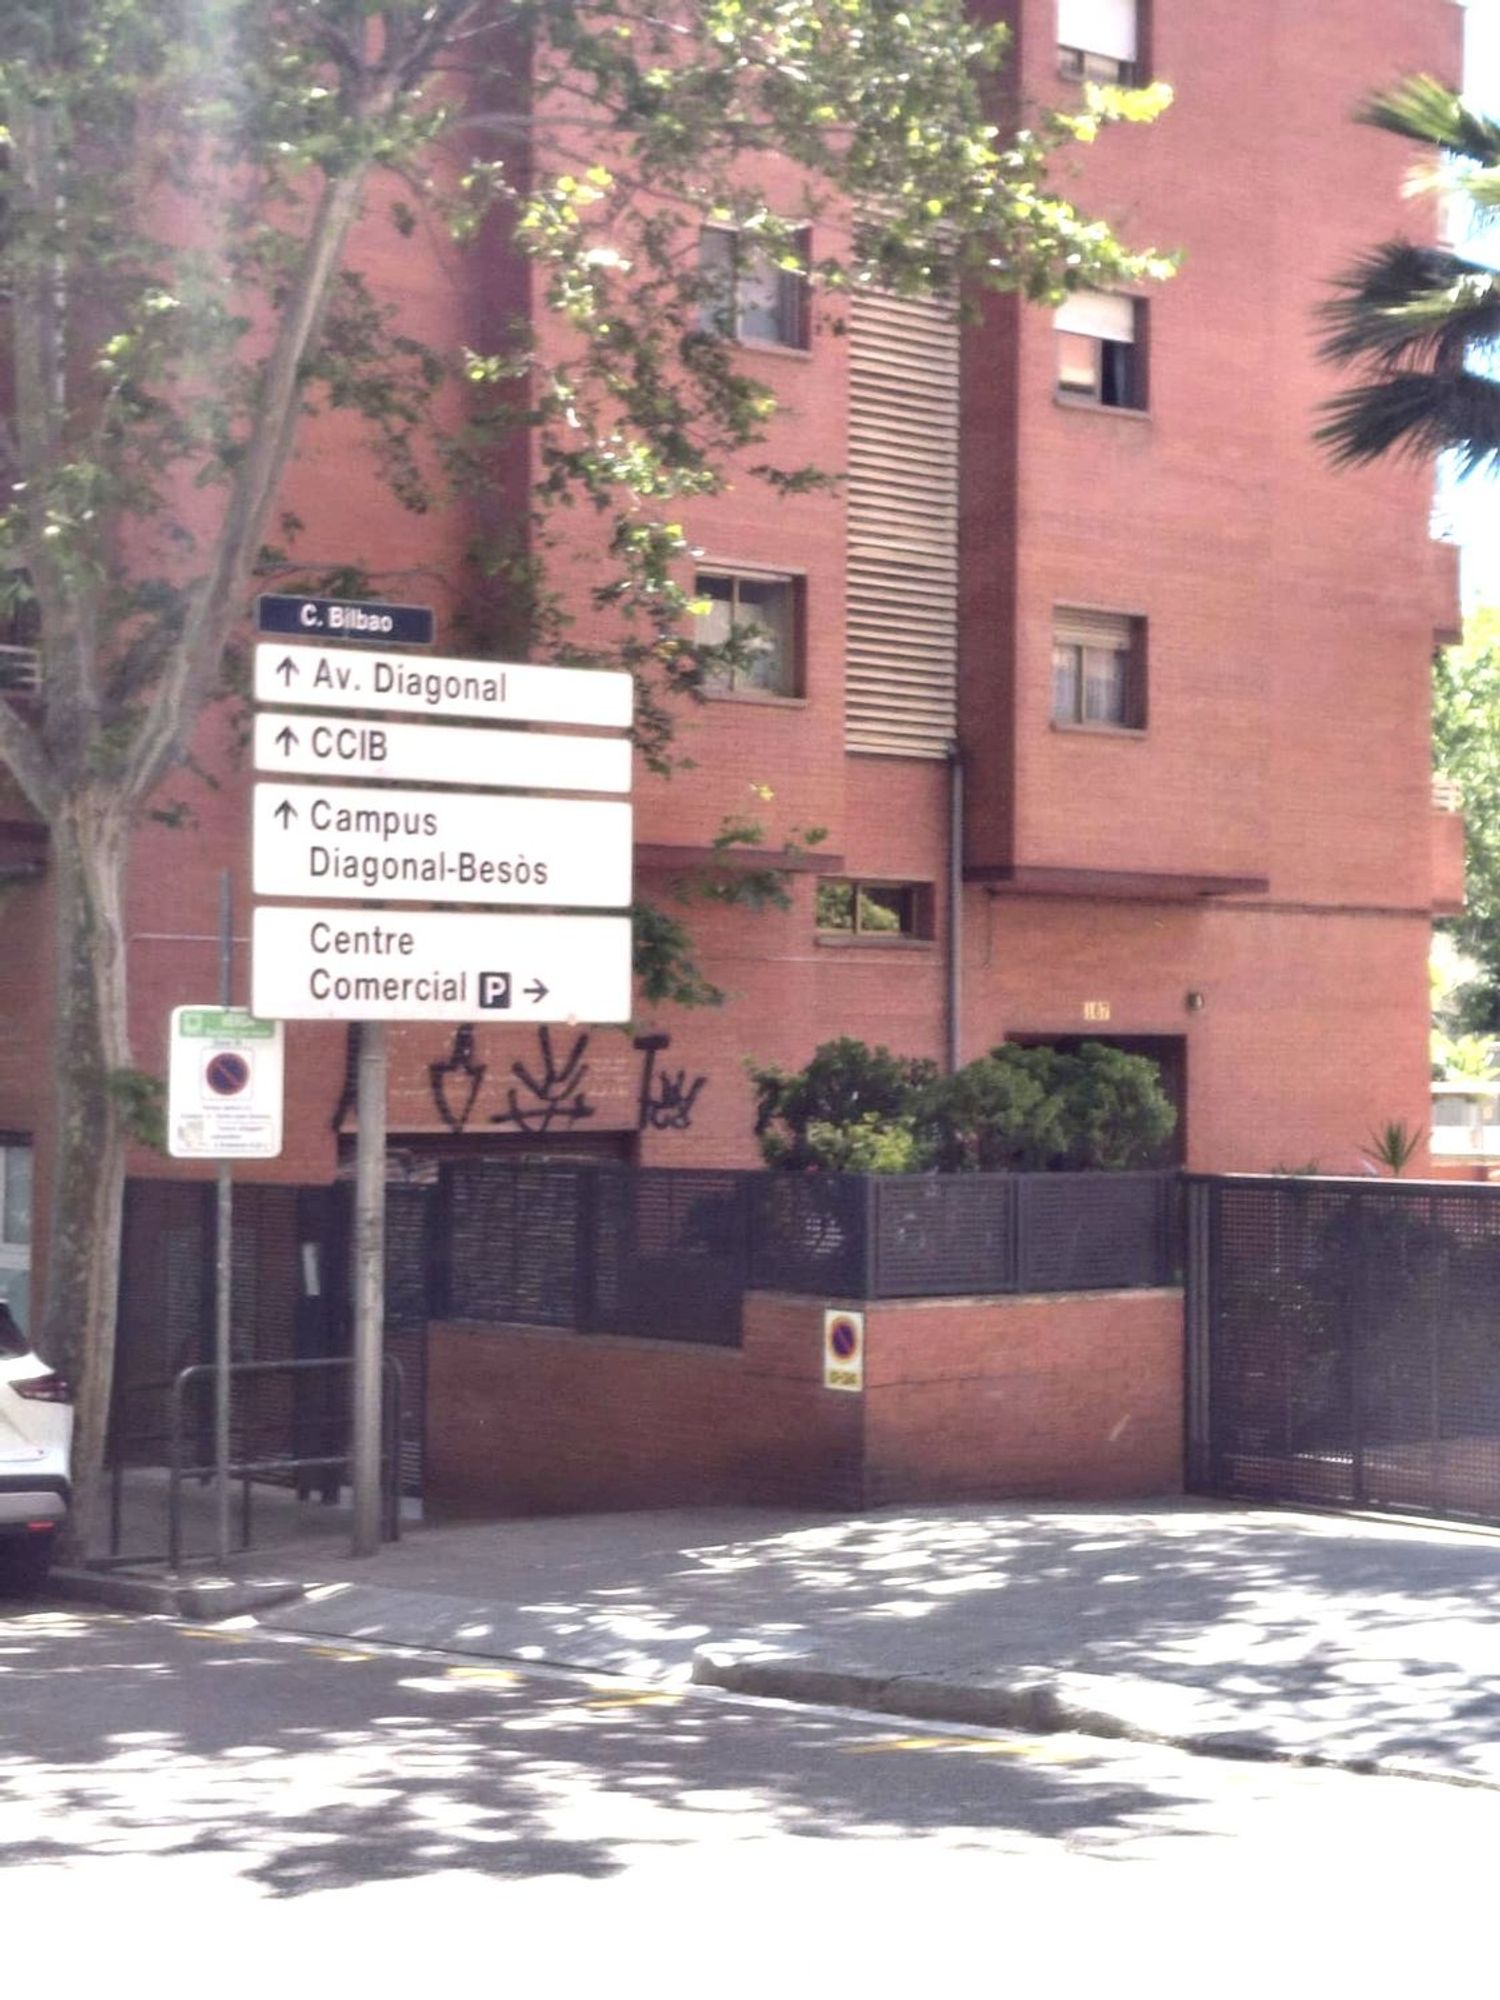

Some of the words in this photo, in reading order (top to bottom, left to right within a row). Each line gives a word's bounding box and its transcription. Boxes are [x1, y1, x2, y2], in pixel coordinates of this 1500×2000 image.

[300, 604, 323, 628] C.
[328, 607, 394, 632] Bilbao
[313, 658, 361, 691] Av.
[374, 661, 507, 705] Diagonal
[311, 726, 388, 761] CCIB
[310, 800, 438, 841] Campus
[309, 846, 549, 886] Diagonal-Besòs
[310, 922, 415, 955] Centre
[309, 968, 467, 1003] Comercial
[482, 974, 508, 1005] P
